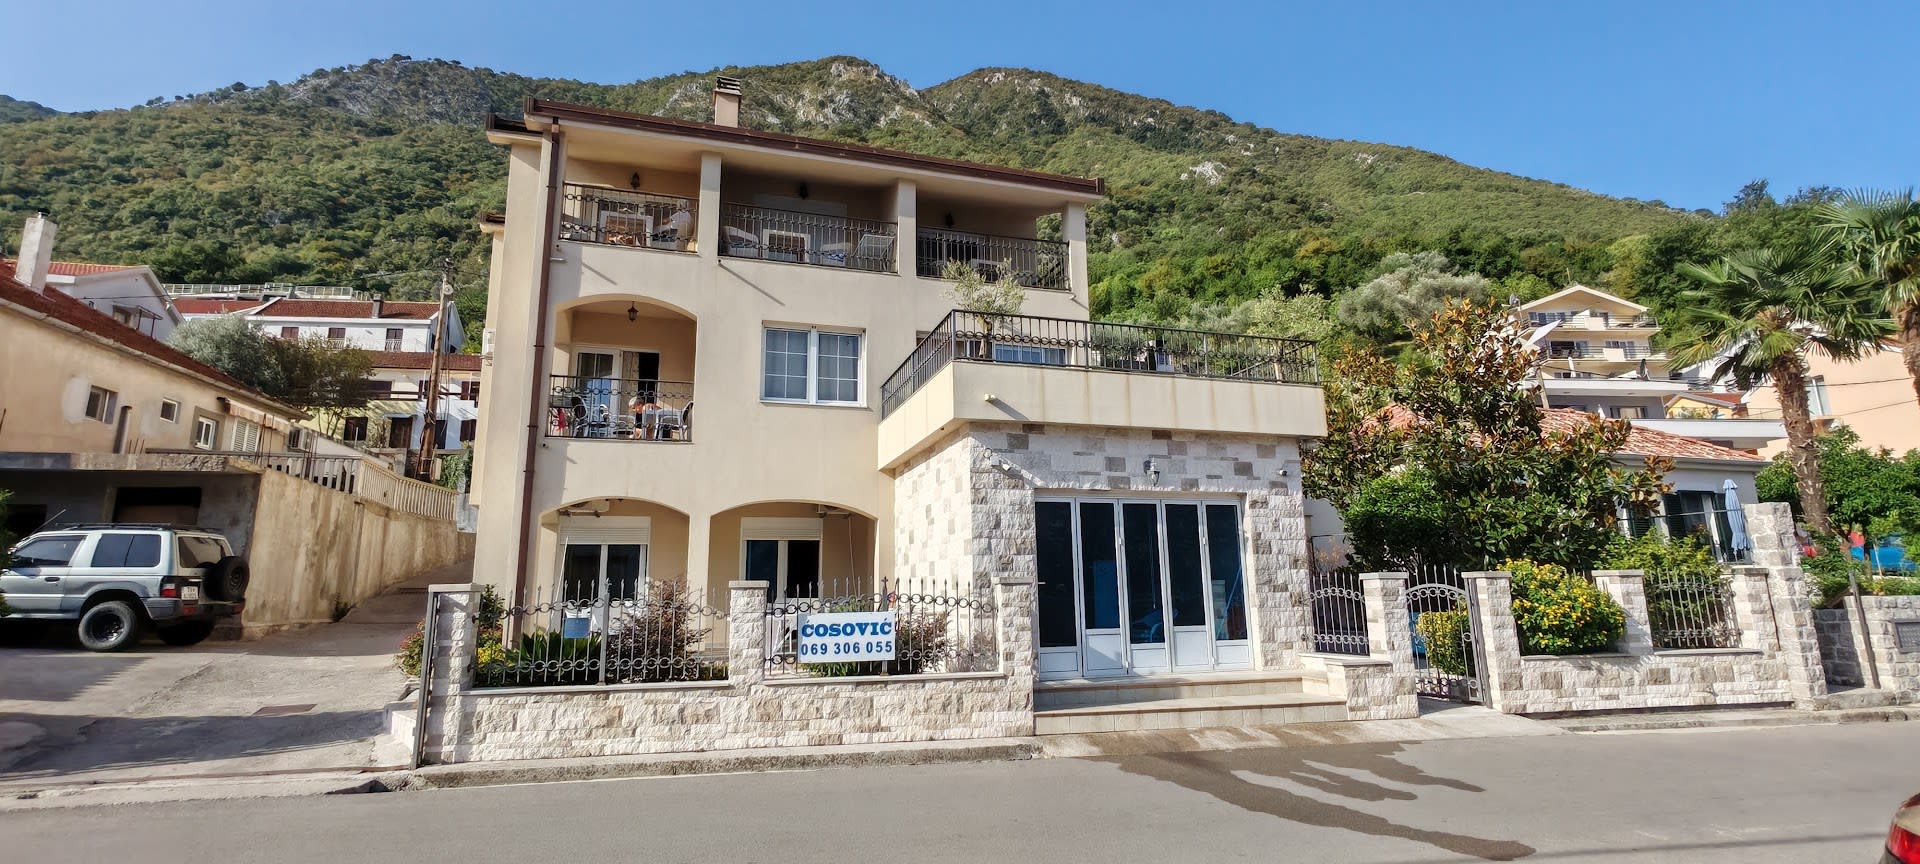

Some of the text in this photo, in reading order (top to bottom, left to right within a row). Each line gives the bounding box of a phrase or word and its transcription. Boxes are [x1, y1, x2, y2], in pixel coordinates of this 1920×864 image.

[801, 618, 892, 638] ĆOSOVIĆ
[801, 641, 893, 656] 069 306 055
